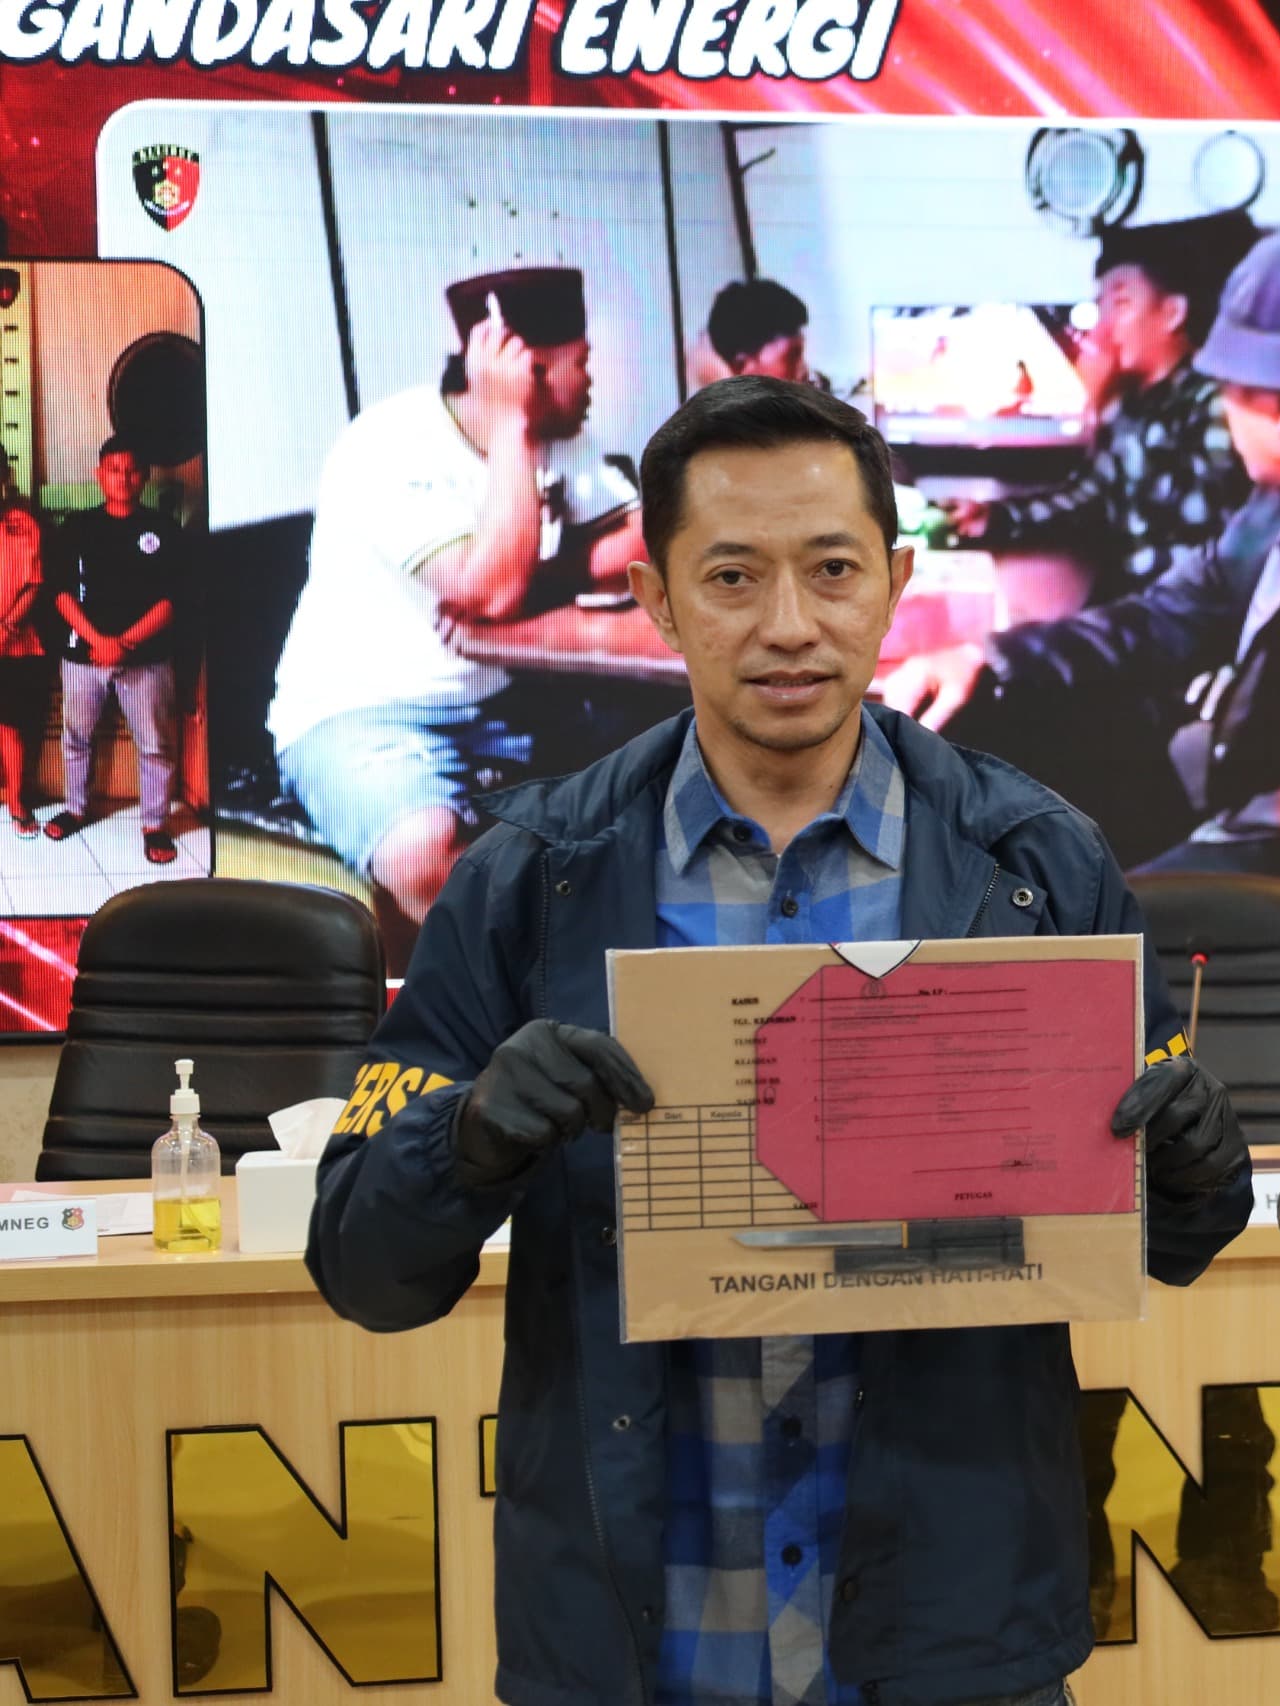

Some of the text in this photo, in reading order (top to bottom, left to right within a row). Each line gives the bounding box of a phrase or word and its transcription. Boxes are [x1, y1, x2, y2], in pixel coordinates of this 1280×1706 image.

[0, 0, 900, 80] GANDASARI ENERGI
[710, 1263, 1043, 1294] TANGANI DENGAN HATI-HATI
